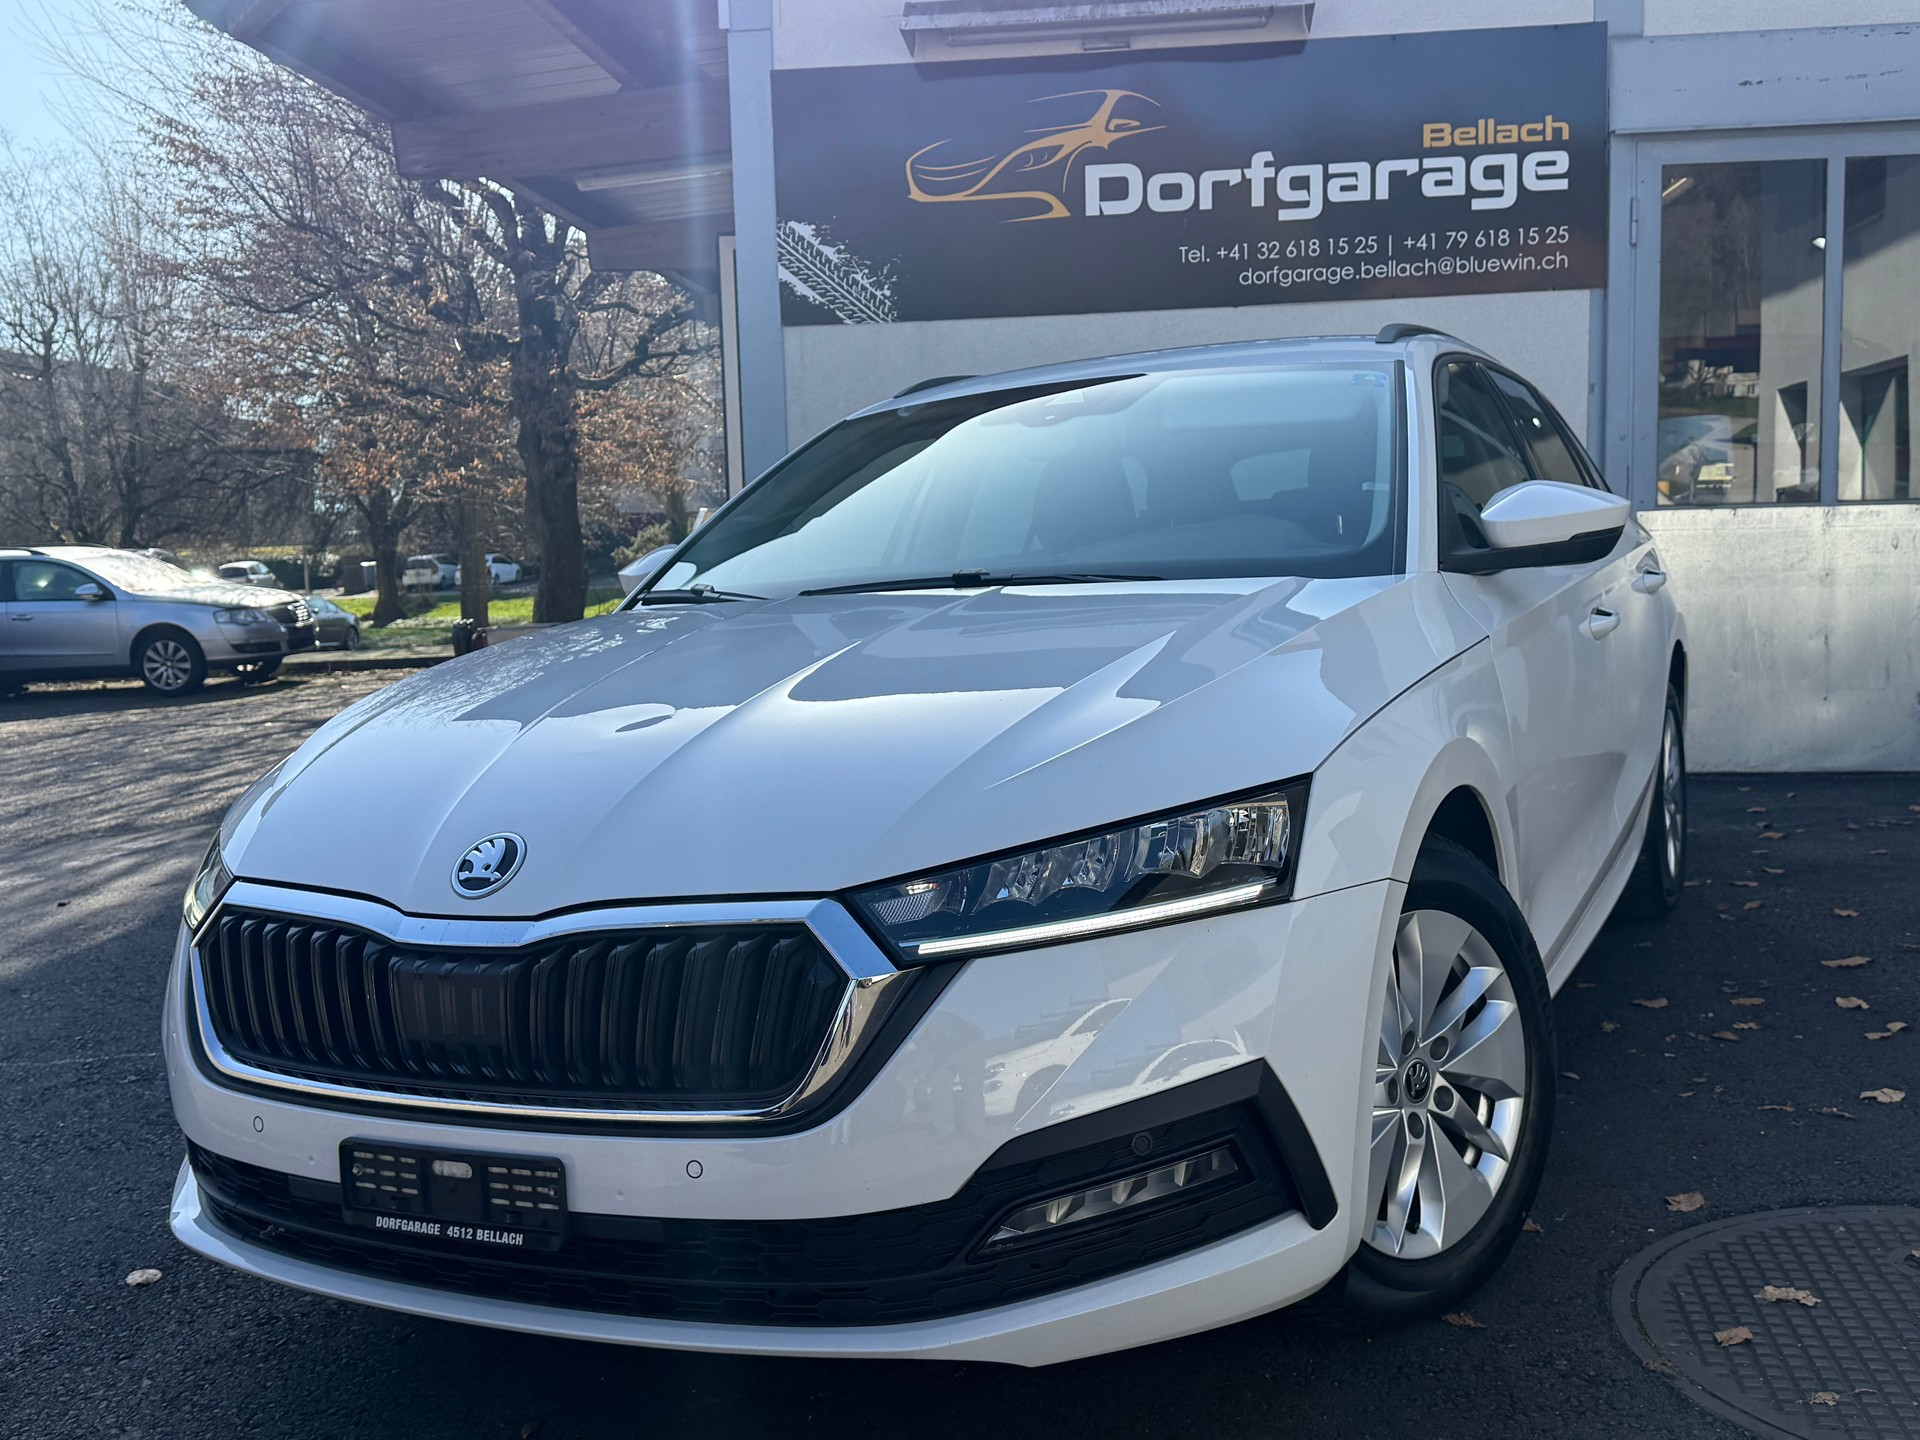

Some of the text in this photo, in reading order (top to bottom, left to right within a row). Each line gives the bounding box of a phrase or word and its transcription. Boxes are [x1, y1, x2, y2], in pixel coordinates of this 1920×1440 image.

[1422, 114, 1570, 148] Bellach
[1084, 150, 1570, 221] Dorfgarage
[1179, 244, 1211, 263] Tel.
[1216, 243, 1249, 261] +41
[1257, 241, 1280, 260] 32
[1286, 238, 1320, 258] 618
[1328, 237, 1349, 256] 15
[1354, 235, 1378, 254] 25
[1403, 233, 1436, 251] +41
[1445, 231, 1468, 249] 79
[1474, 228, 1510, 248] 618
[1518, 227, 1539, 246] 15
[1545, 225, 1569, 244] 25
[1238, 251, 1569, 288] dorfgarage.bellach@bluewin.ch
[375, 1215, 524, 1246] DORFGARAGE 4512 BELLACH
